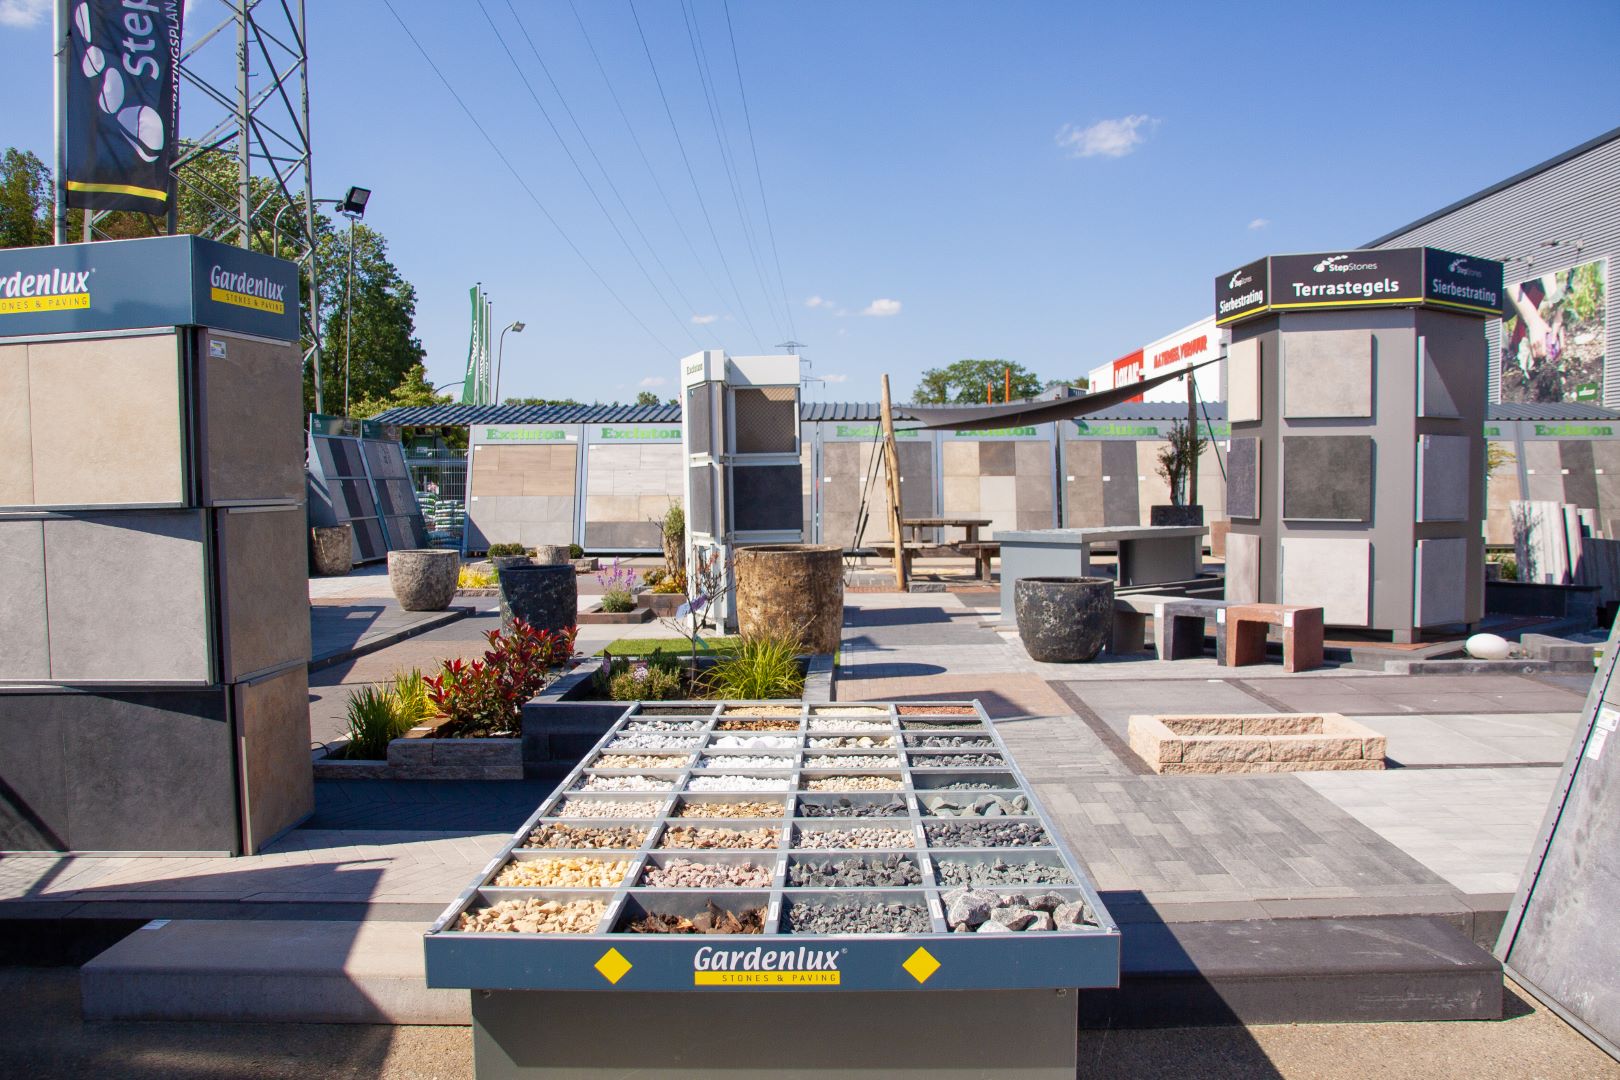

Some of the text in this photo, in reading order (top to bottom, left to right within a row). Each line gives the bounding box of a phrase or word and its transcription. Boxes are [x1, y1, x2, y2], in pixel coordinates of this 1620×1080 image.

[1328, 262, 1378, 273] StepStones
[211, 265, 284, 301] Gardenlux
[1292, 278, 1400, 297] Terrastegels
[1432, 278, 1496, 306] Sierbestrating
[49, 297, 87, 306] PAVING
[226, 293, 250, 305] STONES
[261, 301, 283, 313] PAVING
[1219, 289, 1264, 314] Sierbestrating
[486, 428, 566, 440] Excluton
[601, 427, 681, 439] Excluton
[1534, 424, 1613, 436] Excluton
[694, 946, 840, 970] Gardenlux
[722, 973, 836, 982] STONES & PAVING
